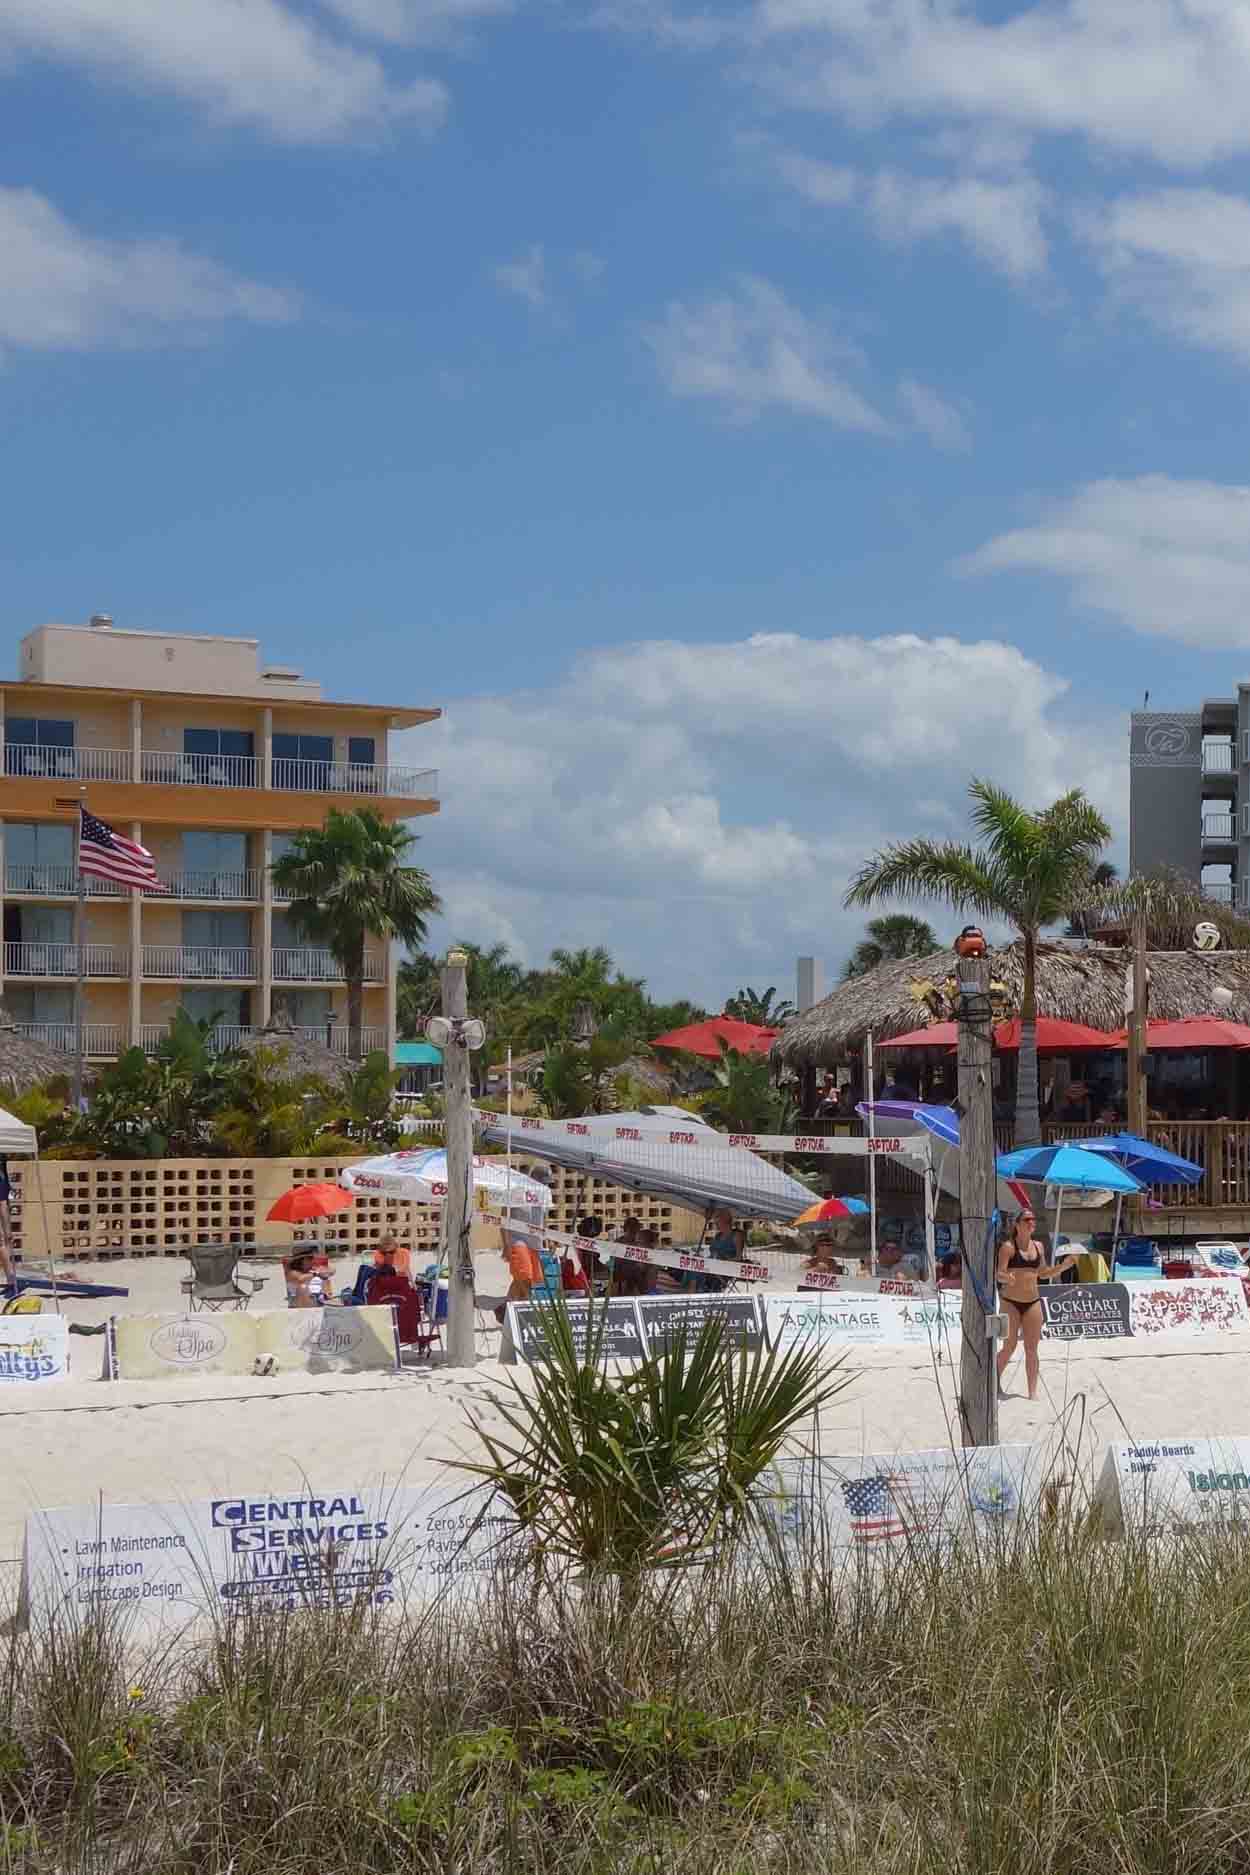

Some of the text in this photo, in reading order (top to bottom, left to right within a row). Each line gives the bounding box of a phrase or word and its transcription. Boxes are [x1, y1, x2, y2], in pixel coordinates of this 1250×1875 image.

[1040, 1296, 1120, 1322] LOCKHART
[785, 1312, 881, 1326] ADVANTAGE
[903, 1312, 962, 1328] ADVANT
[1050, 1323, 1126, 1337] REAL ESTATE
[1128, 1445, 1195, 1459] Paddle Boards
[1131, 1461, 1157, 1473] Bikes
[212, 1497, 365, 1527] CENTRAL
[426, 1516, 455, 1532] Zero
[75, 1535, 186, 1556] Lawn Maintenance
[231, 1521, 389, 1552] SERVICES
[77, 1560, 143, 1582] Irrigation
[78, 1580, 182, 1604] Landscape Design
